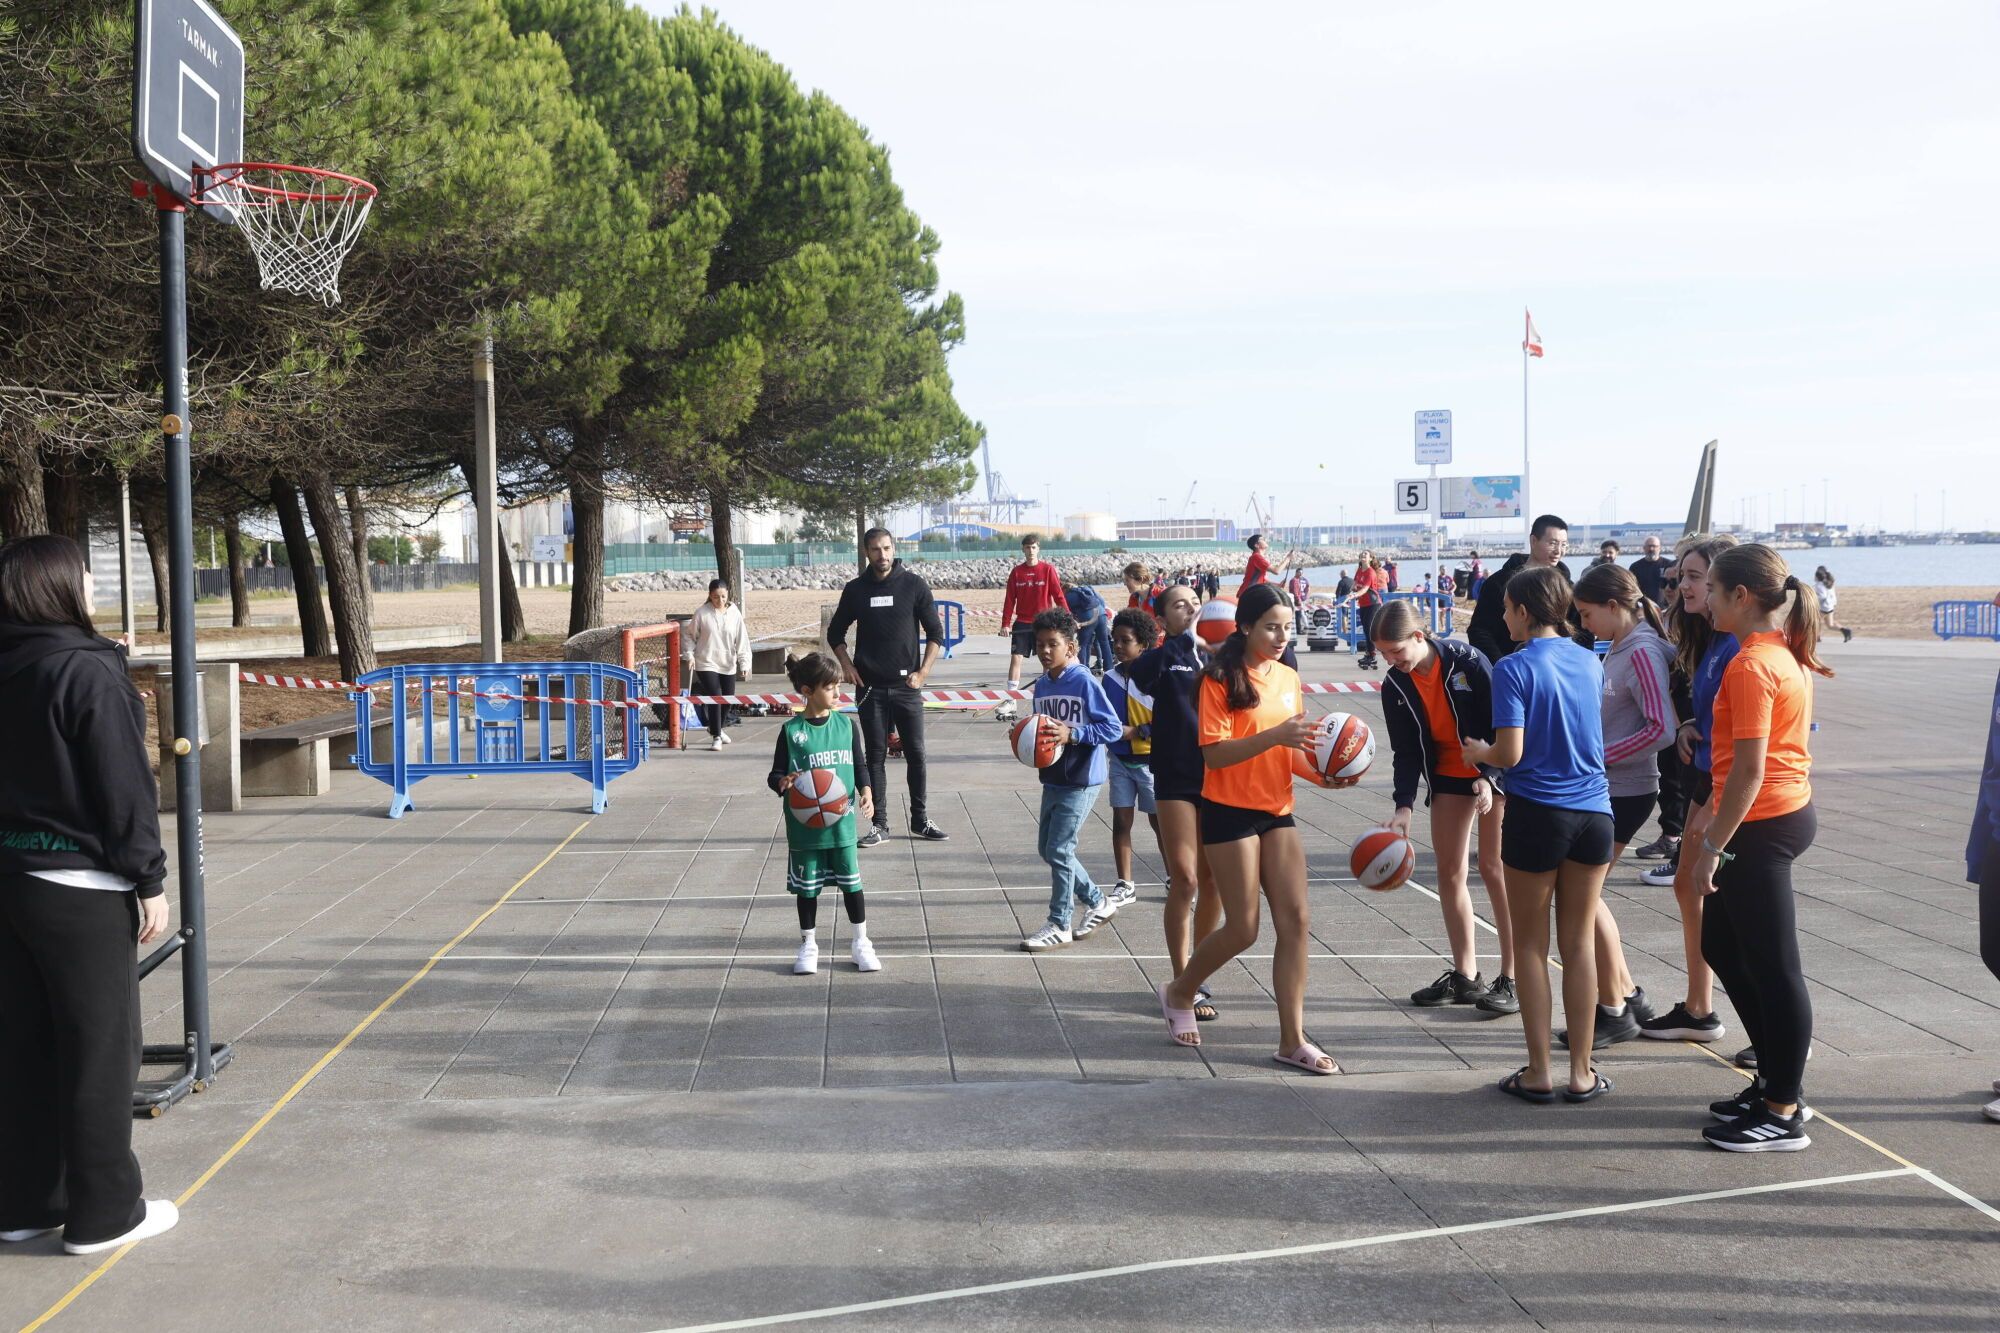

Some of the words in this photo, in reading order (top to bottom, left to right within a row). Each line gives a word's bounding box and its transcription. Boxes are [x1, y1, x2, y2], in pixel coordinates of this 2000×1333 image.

[182, 18, 218, 68] TARMAK
[1406, 486, 1419, 507] 5
[1339, 735, 1359, 761] sport
[798, 864, 805, 878] 7
